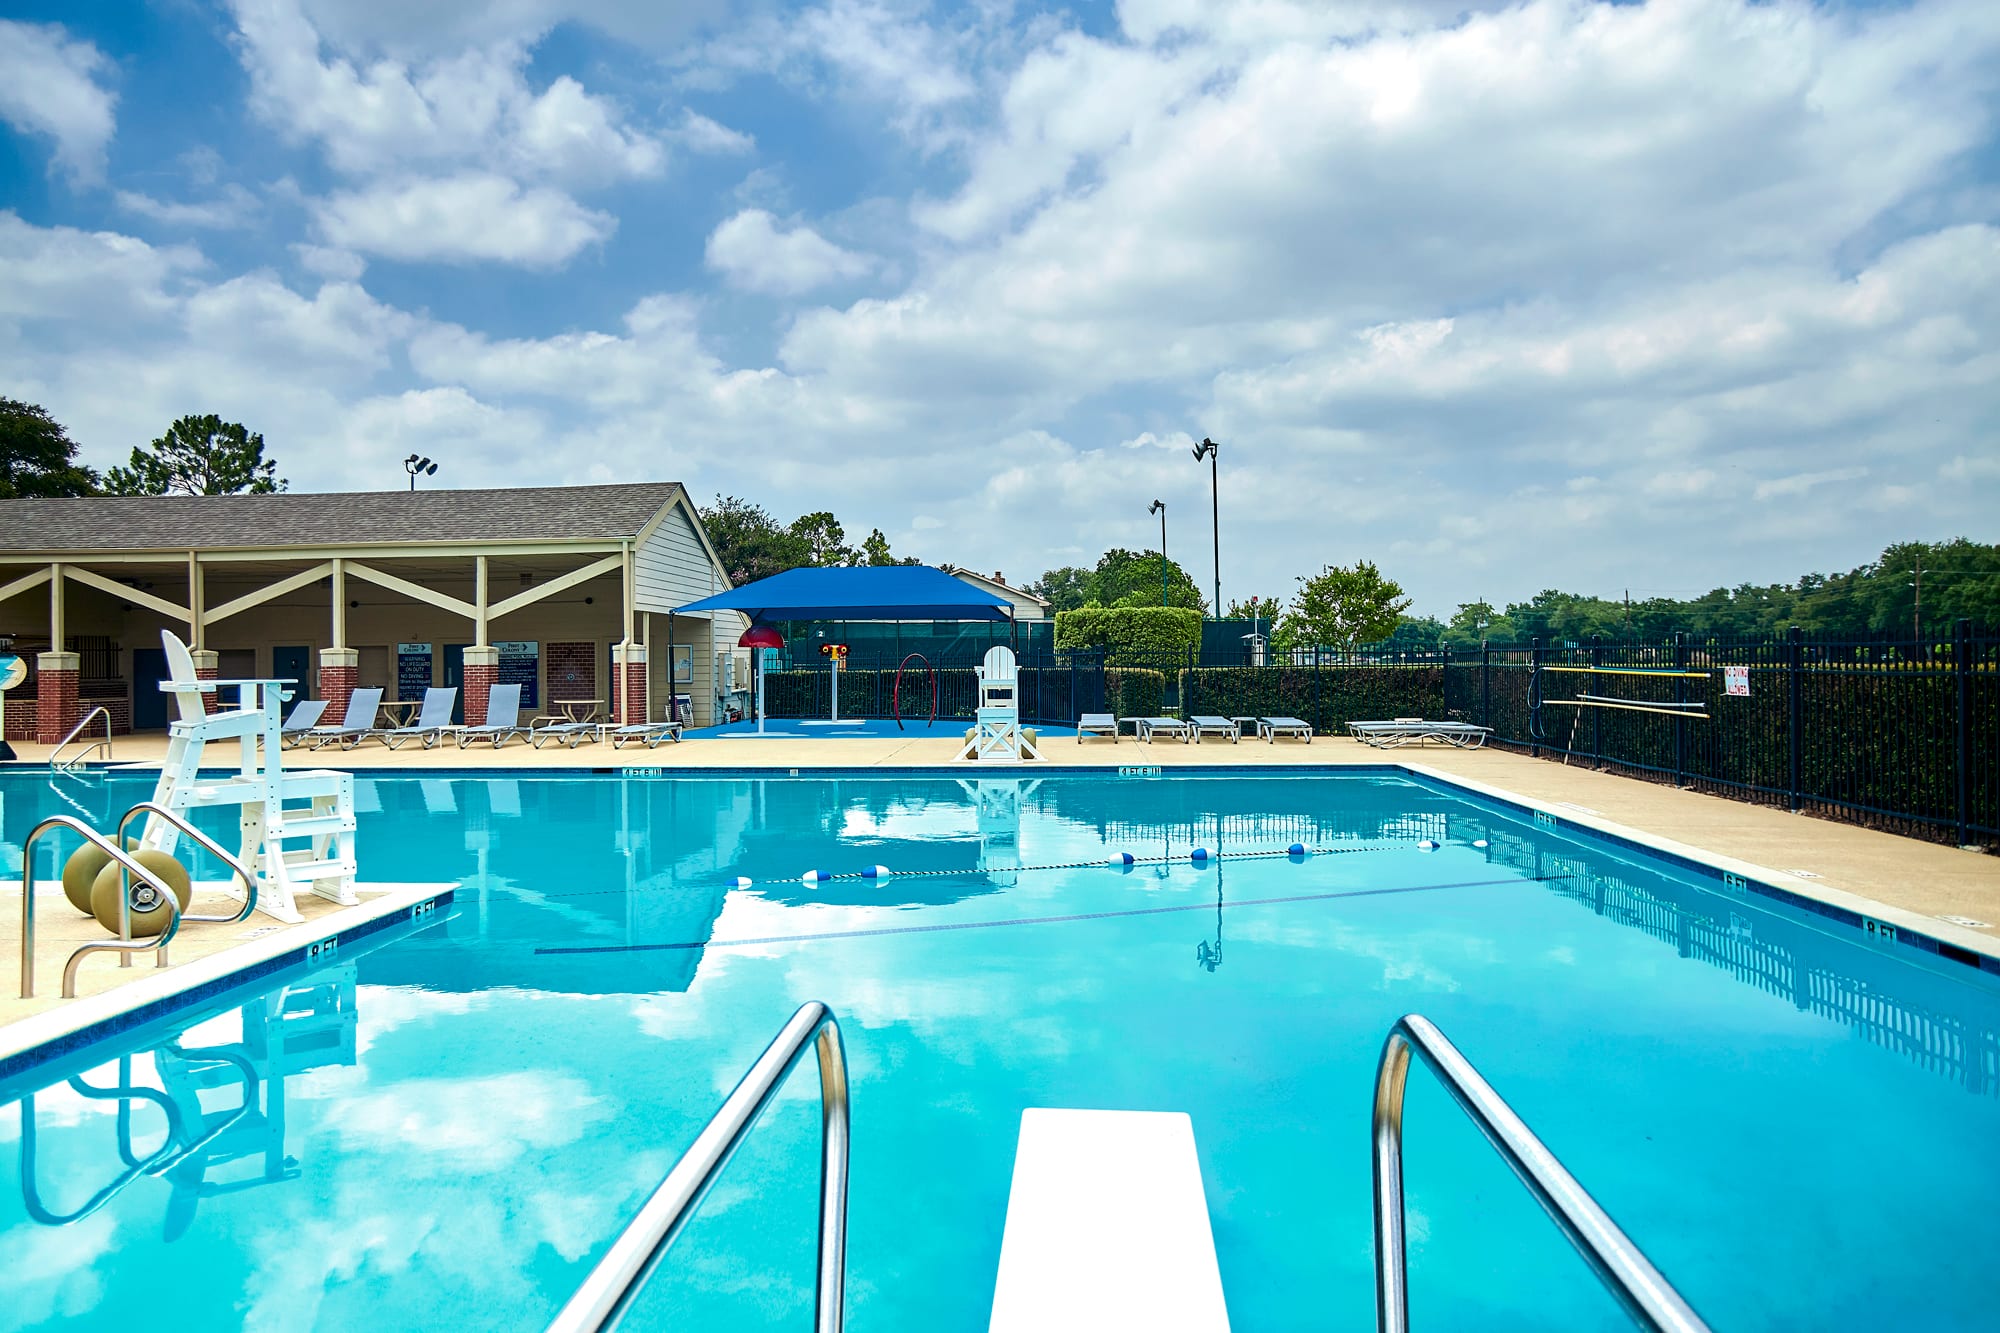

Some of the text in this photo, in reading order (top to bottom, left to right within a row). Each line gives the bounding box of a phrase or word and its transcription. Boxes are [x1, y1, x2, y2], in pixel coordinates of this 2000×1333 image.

[1725, 667, 1732, 677] NO
[1726, 874, 1746, 889] 6 FT
[424, 900, 434, 913] FT
[1880, 924, 1895, 939] FT
[323, 937, 337, 953] FT
